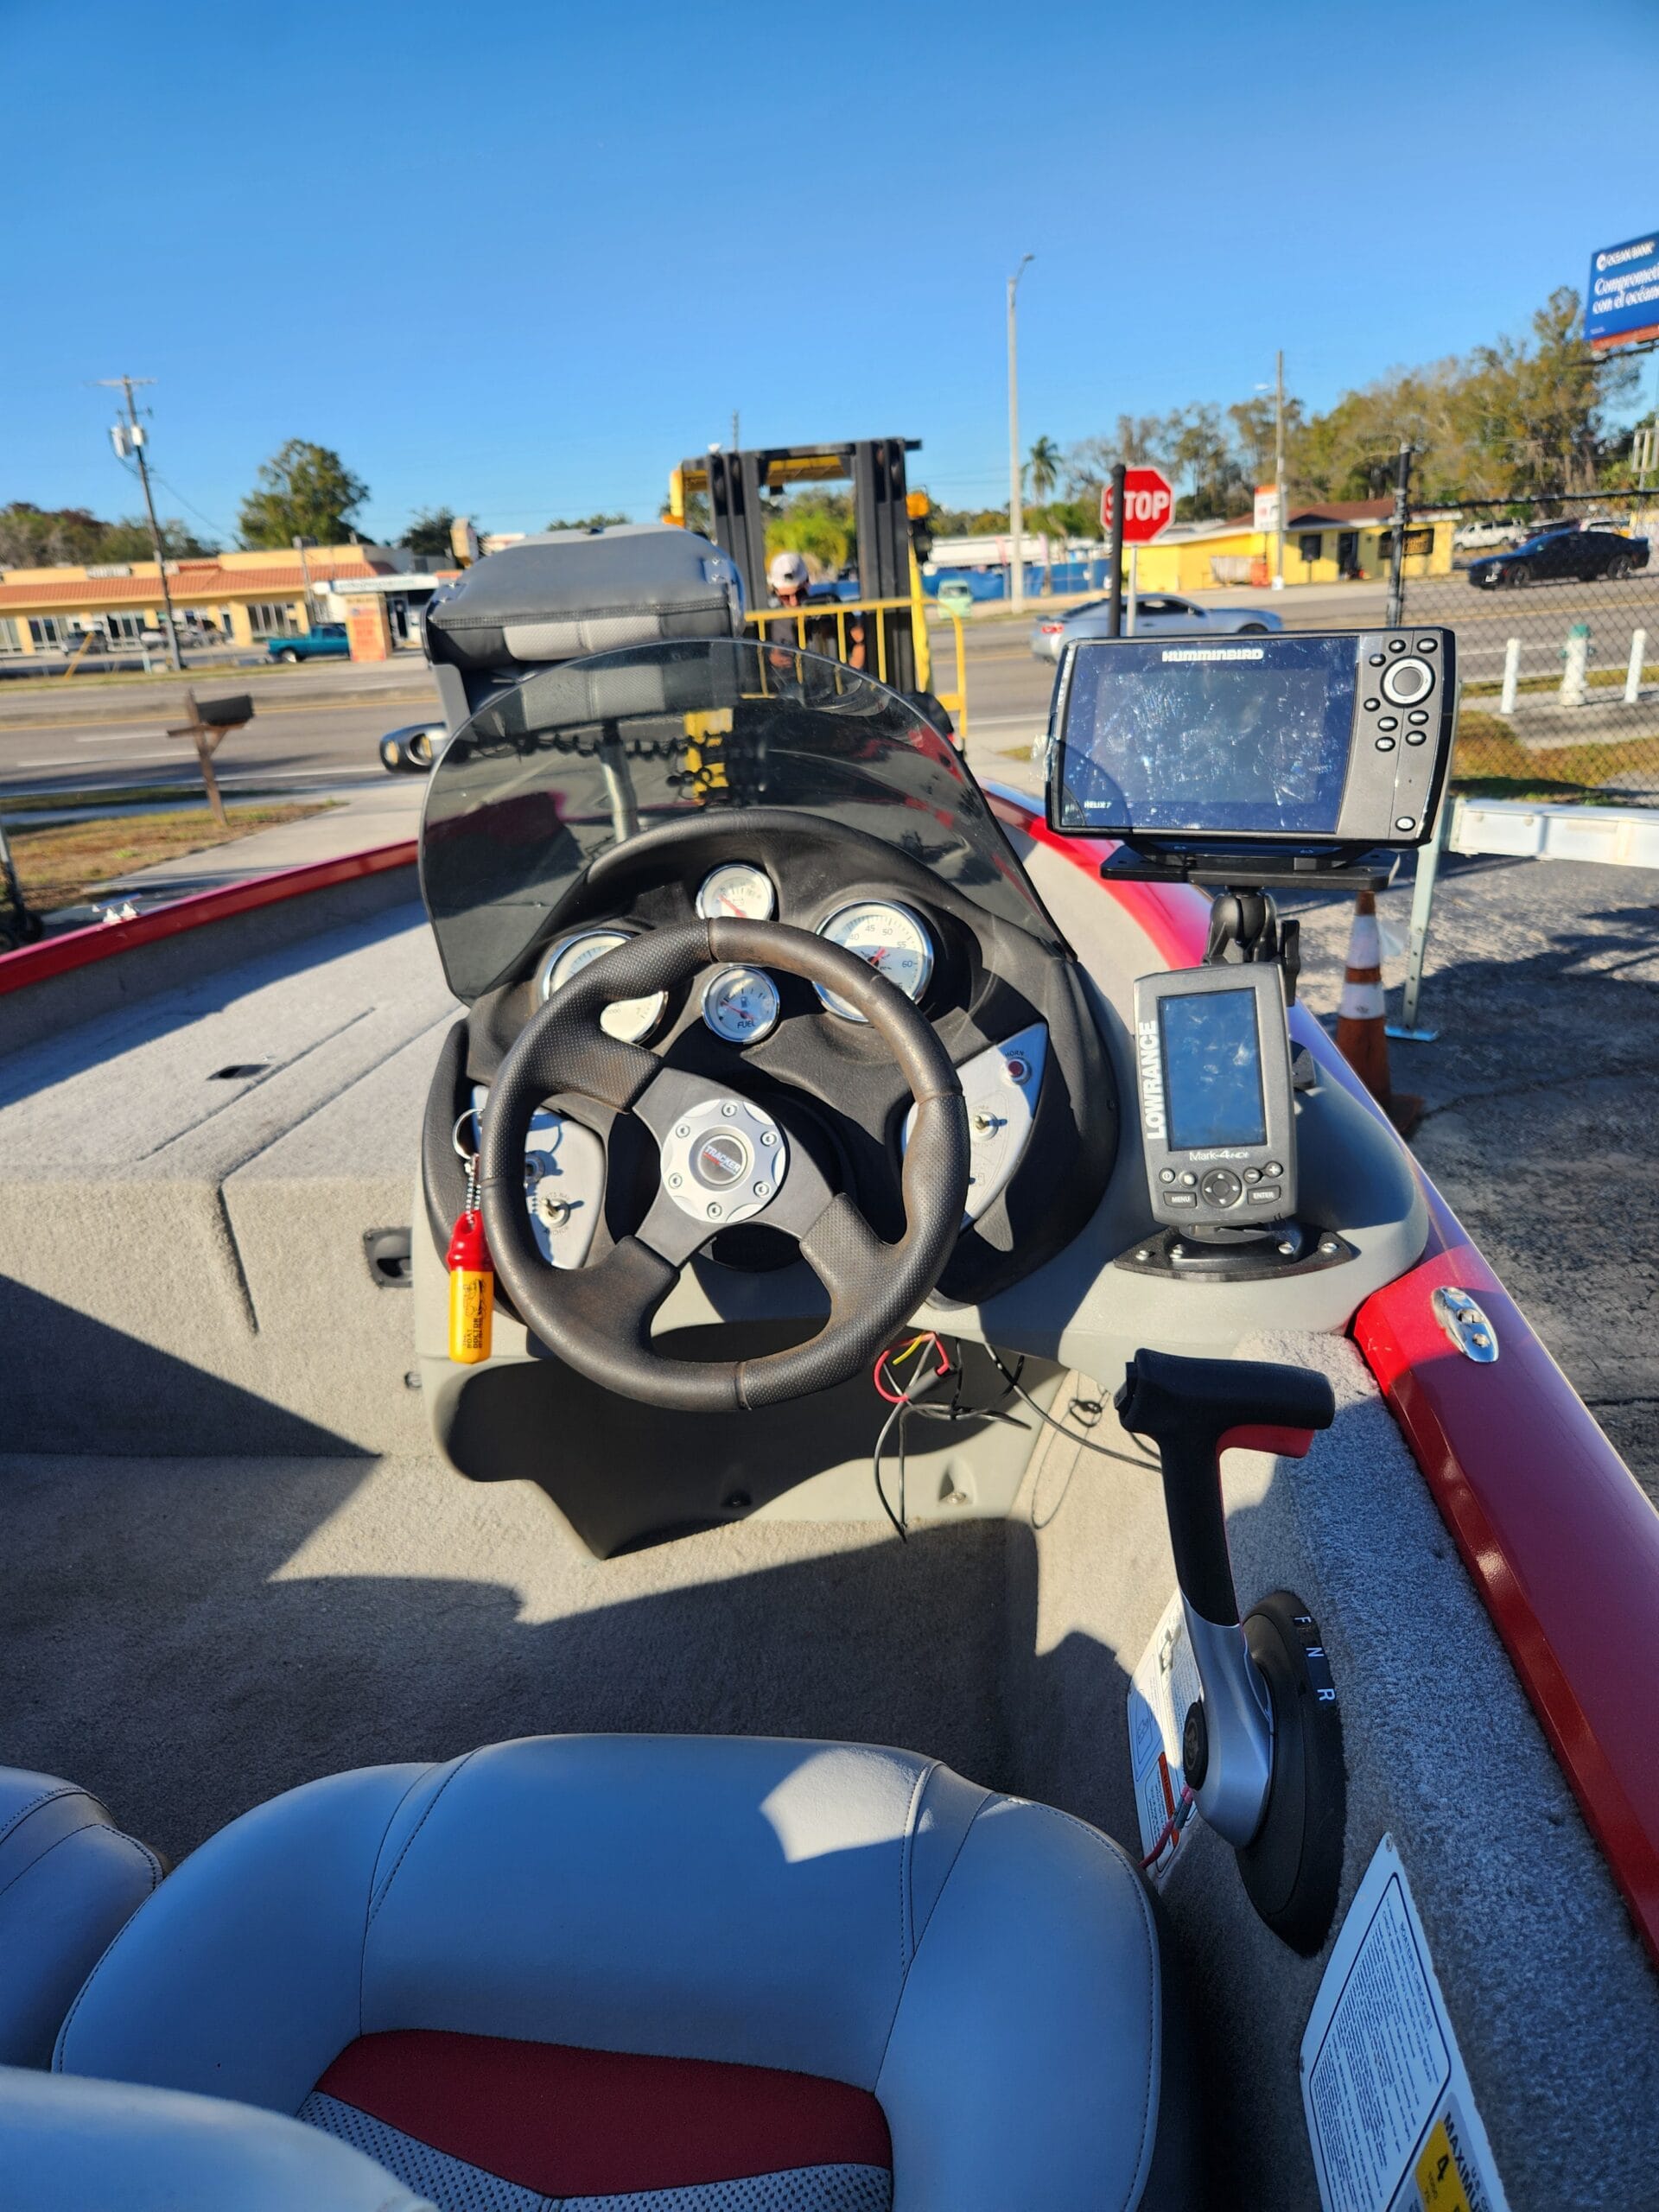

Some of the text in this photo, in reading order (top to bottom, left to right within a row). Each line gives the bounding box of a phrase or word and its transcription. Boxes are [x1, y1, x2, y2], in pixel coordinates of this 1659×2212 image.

[1592, 296, 1612, 315] con
[1613, 289, 1624, 308] el
[1162, 649, 1264, 662] HUMMINBIRD
[737, 1020, 755, 1029] FUEL
[1139, 1020, 1166, 1140] LOWRANCE
[704, 1145, 741, 1173] TRACKER
[1171, 1195, 1191, 1204] MENU
[1253, 1192, 1274, 1200] ENTER
[1306, 1647, 1325, 1657] N
[1317, 1688, 1336, 1700] R
[1437, 2154, 1449, 2182] 4
[1444, 2111, 1482, 2212] MAXIMU
